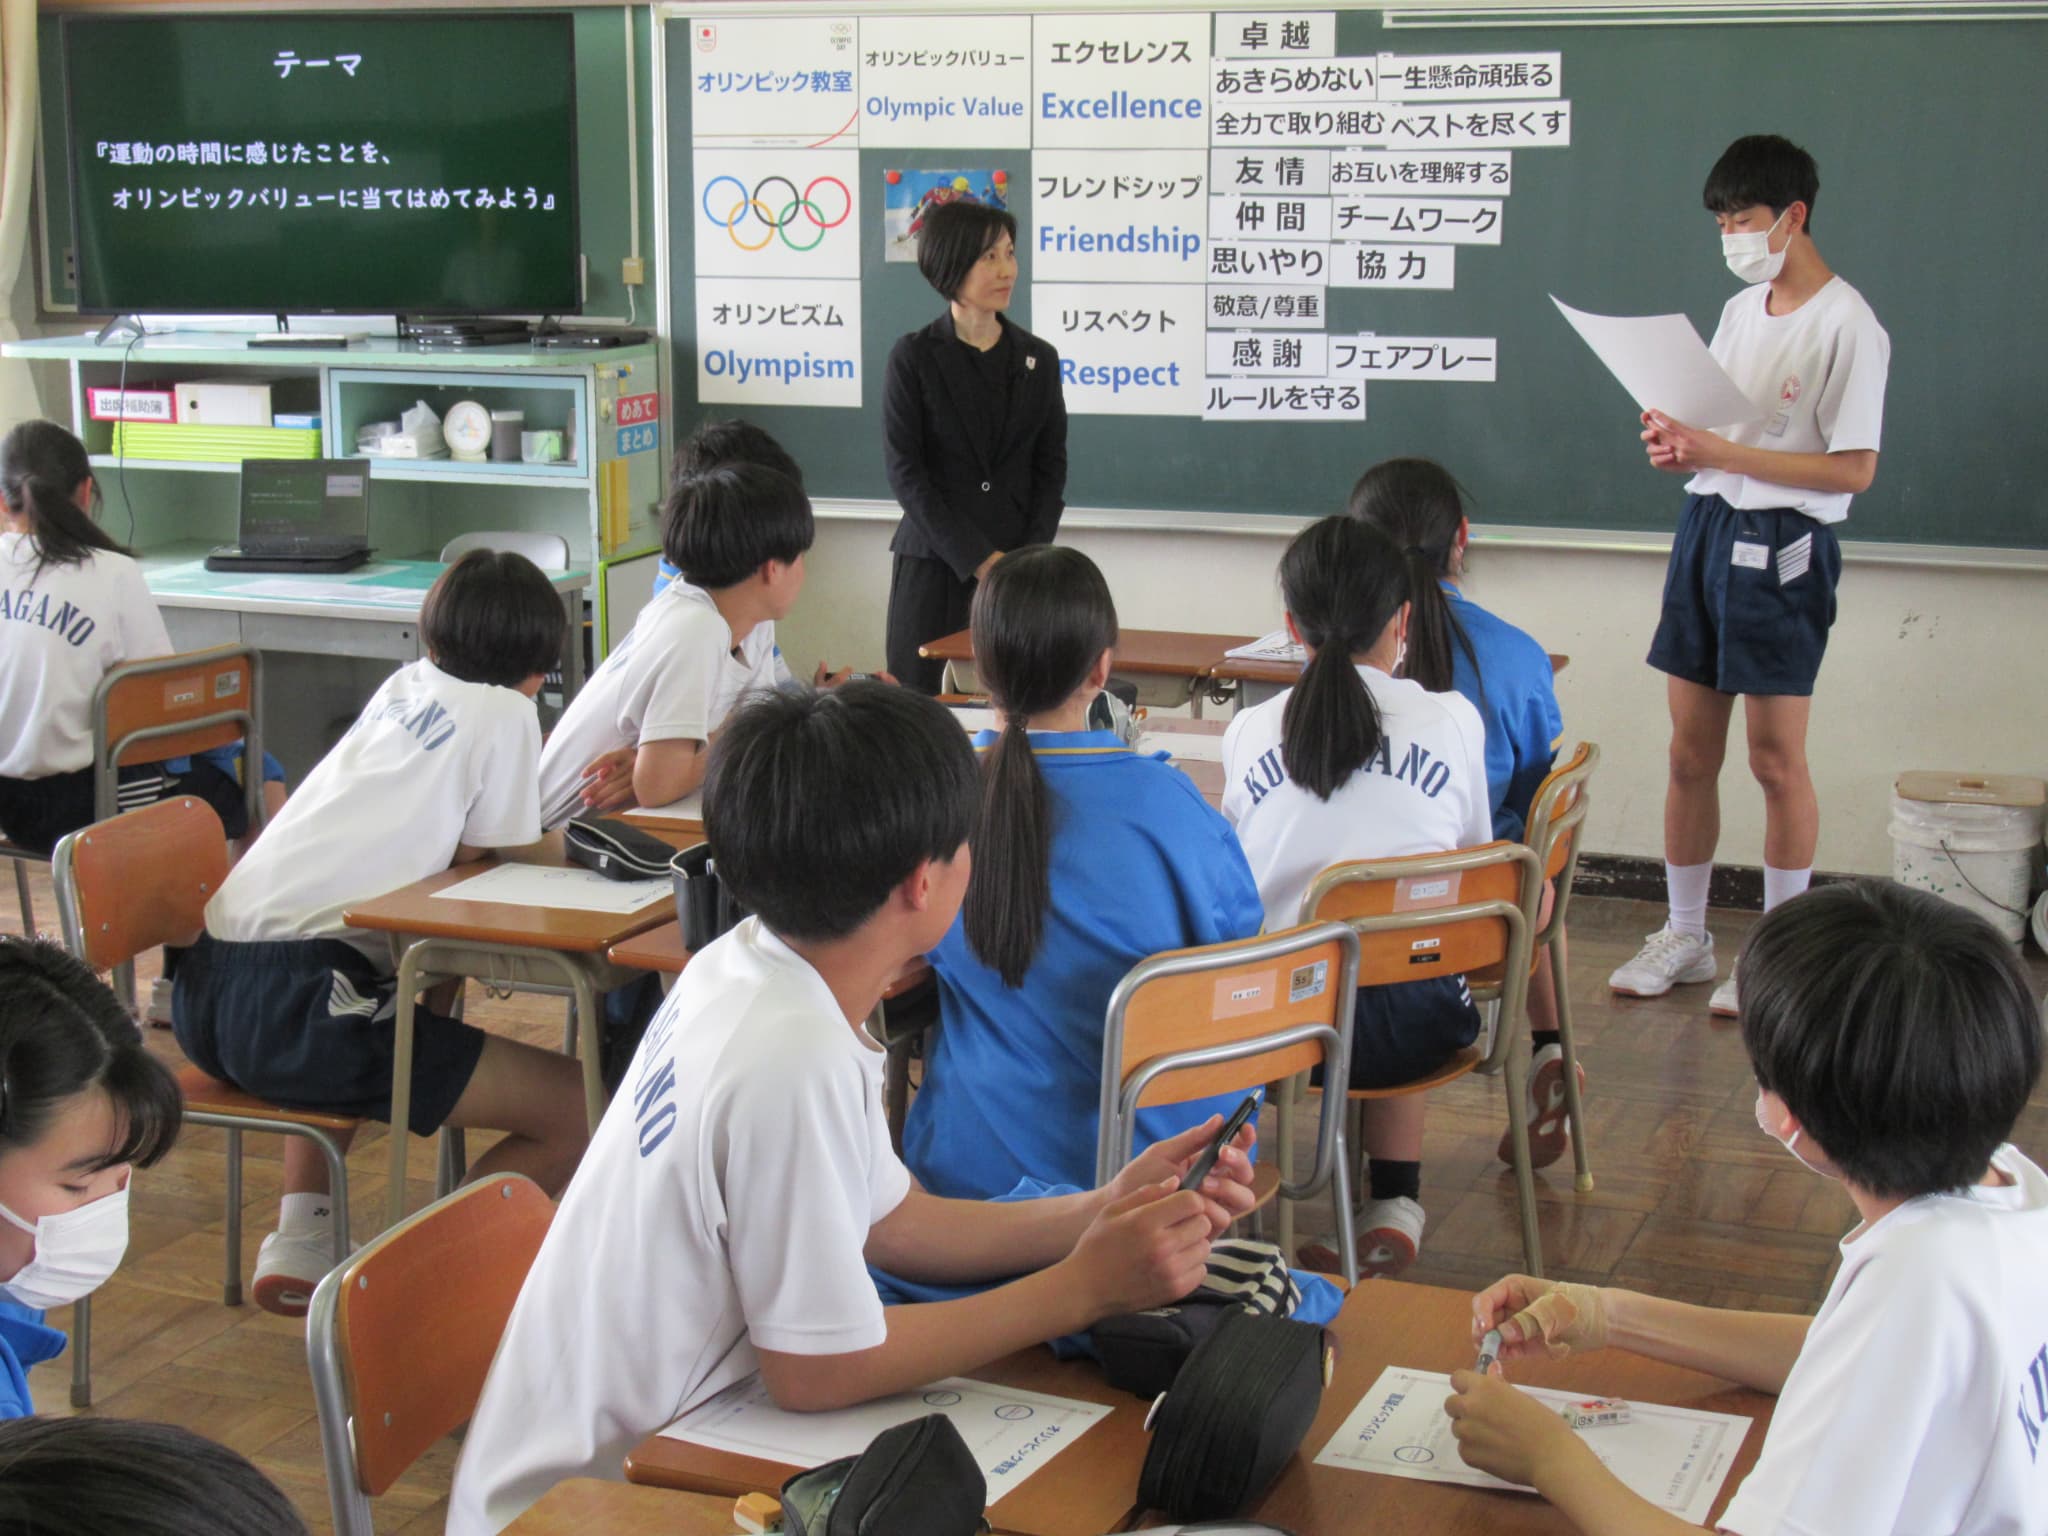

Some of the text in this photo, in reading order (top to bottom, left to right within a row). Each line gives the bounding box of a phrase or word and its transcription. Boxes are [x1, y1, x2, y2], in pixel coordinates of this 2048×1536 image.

[1240, 20, 1310, 50] 卓越
[273, 51, 362, 79] テーマ
[865, 49, 1025, 67] オリンピックバリュー
[1050, 40, 1192, 65] エクセレンス
[698, 70, 853, 93] オリンピック教室
[1216, 67, 1374, 94] あきらめない
[1379, 63, 1553, 90] 一生懸命頑張る
[866, 96, 1024, 121] Olympic Value
[1042, 91, 1203, 119] Excellence
[1215, 111, 1386, 136] 全力で取り組む
[1391, 110, 1567, 138] ベストを尽くす
[96, 141, 390, 166] 『運動の時間に感じたことを、
[1235, 157, 1305, 186] 友情
[1331, 161, 1509, 184] お互いを理解する
[113, 186, 555, 211] オリンピックバリューに当てはめてみよう』
[1038, 175, 1203, 199] フレンドシップ
[1235, 201, 1305, 232] 仲間
[1337, 205, 1497, 233] チームワーク
[1039, 225, 1201, 261] Friendship
[1211, 248, 1323, 276] 思いやり
[1356, 250, 1426, 280] 協力
[712, 304, 844, 327] オリンピズム
[1213, 294, 1319, 320] 敬意/尊重
[1062, 309, 1176, 333] リスペクト
[703, 350, 854, 384] Olympism
[1232, 338, 1303, 369] 感謝
[1335, 343, 1493, 371] フェアプレー
[1058, 359, 1180, 393] Respect
[621, 398, 654, 421] めあて
[1206, 385, 1361, 411] ルールを守る
[621, 428, 654, 453] まとめ
